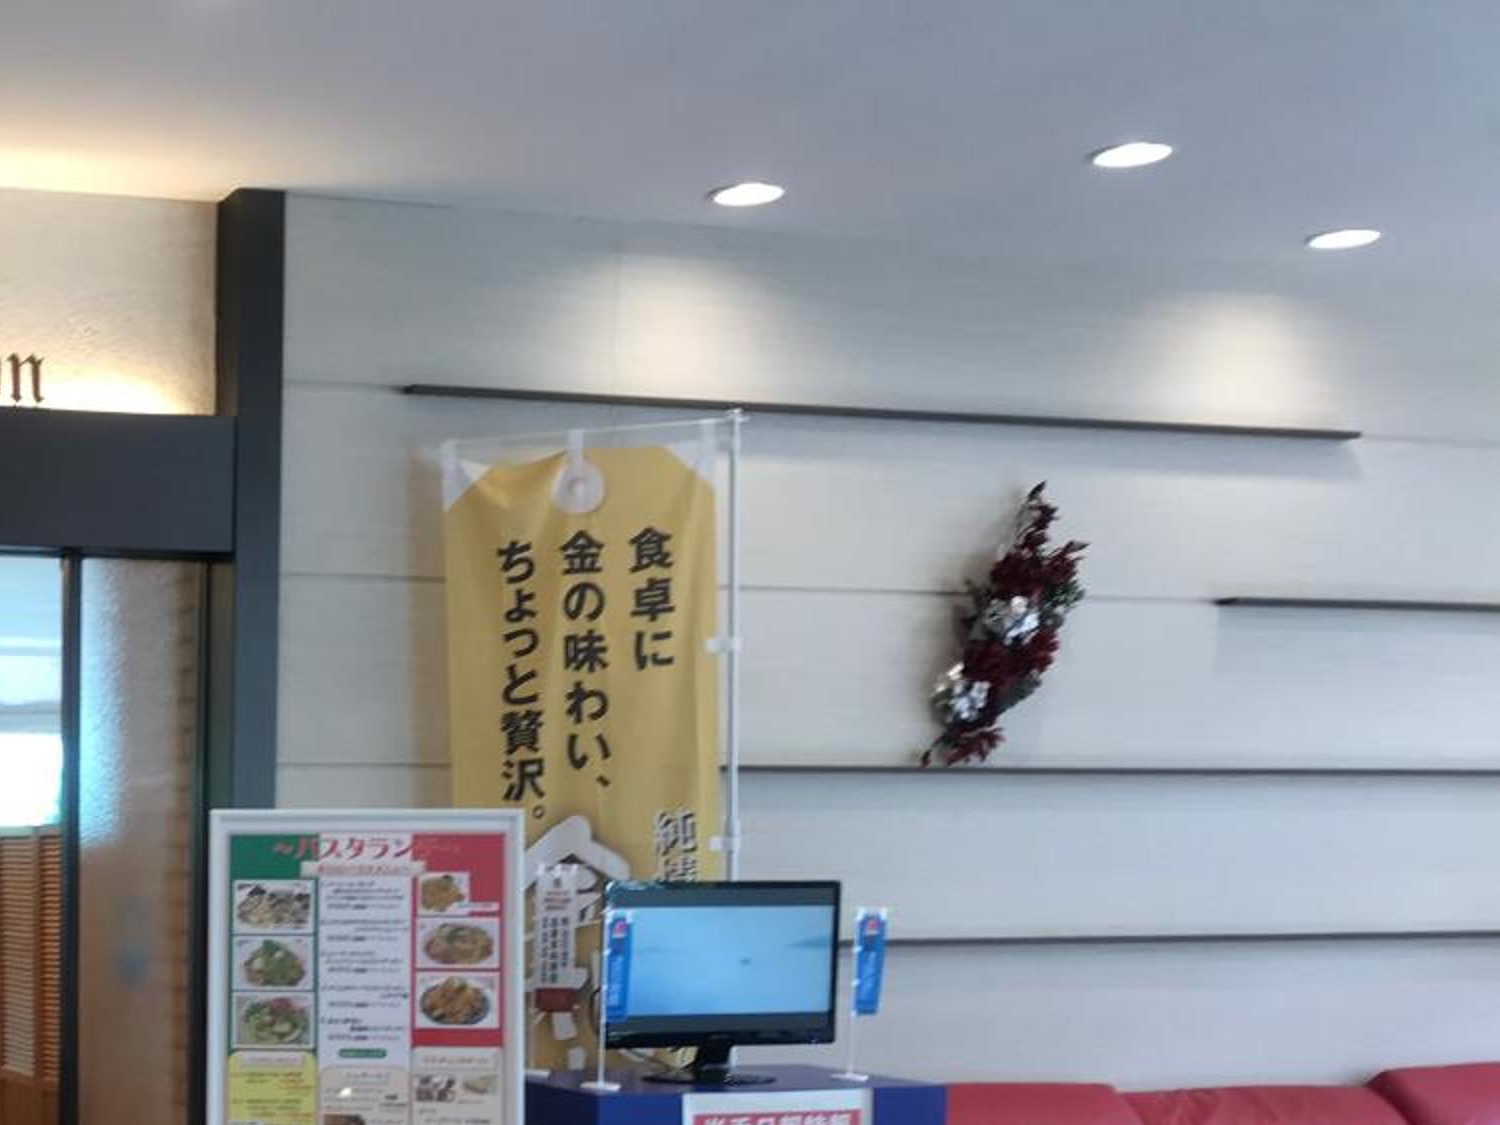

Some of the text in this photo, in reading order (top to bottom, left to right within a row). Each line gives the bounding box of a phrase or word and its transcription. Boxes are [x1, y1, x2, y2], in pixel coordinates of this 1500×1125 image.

[496, 540, 546, 820] ちょっと贅沢。
[560, 530, 612, 787] 金の味わい、
[628, 527, 676, 670] 食卓に
